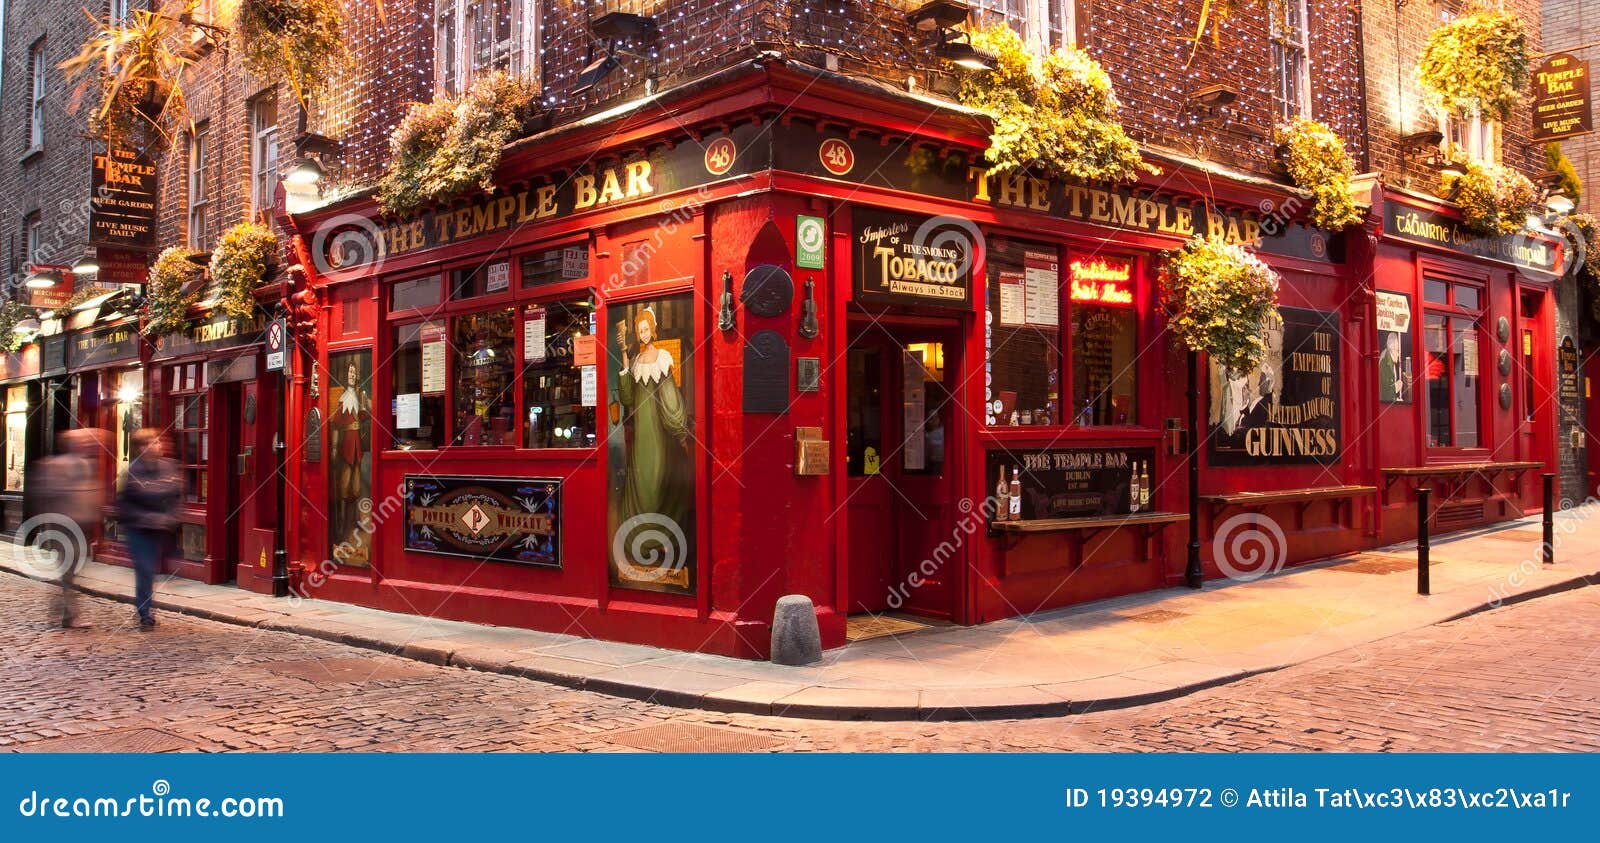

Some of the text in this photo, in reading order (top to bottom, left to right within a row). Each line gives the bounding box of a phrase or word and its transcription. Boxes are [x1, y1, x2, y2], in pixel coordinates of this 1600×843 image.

[1551, 58, 1568, 67] THE
[1537, 68, 1584, 85] TEMPLE
[1547, 81, 1574, 94] BAR
[1556, 99, 1584, 109] GARDEN
[1543, 118, 1581, 129] LIVE MUSIC
[1552, 125, 1572, 133] DAILY
[114, 150, 136, 159] THE
[710, 145, 730, 171] 48
[826, 145, 847, 169] 48
[94, 155, 156, 176] TEMPLE
[108, 170, 142, 186] BAR
[92, 197, 154, 210] BEER GARDEN
[374, 159, 654, 257] THE TEMPLE BAR
[969, 166, 1263, 249] THE TEMPLE BAR
[96, 221, 149, 232] LIVE MUSIC
[109, 229, 137, 237] DAILY
[890, 236, 900, 245] OF
[801, 253, 820, 261] 2009
[903, 243, 957, 260] FINE SMOKING
[873, 246, 958, 287] TOBACCO
[891, 282, 964, 297] Always in Stock
[115, 330, 129, 344] BAR
[193, 320, 238, 344] TEMPLE
[1292, 352, 1331, 374] EMPEROR
[1321, 376, 1332, 396] OF
[1267, 397, 1336, 425] MALTED LIQUORS
[1245, 427, 1337, 457] GUINNESS
[1023, 452, 1129, 471] THE TEMPLE BAR
[1065, 471, 1091, 481] DUBLIN
[422, 508, 543, 531] POWERS P WHISKEY
